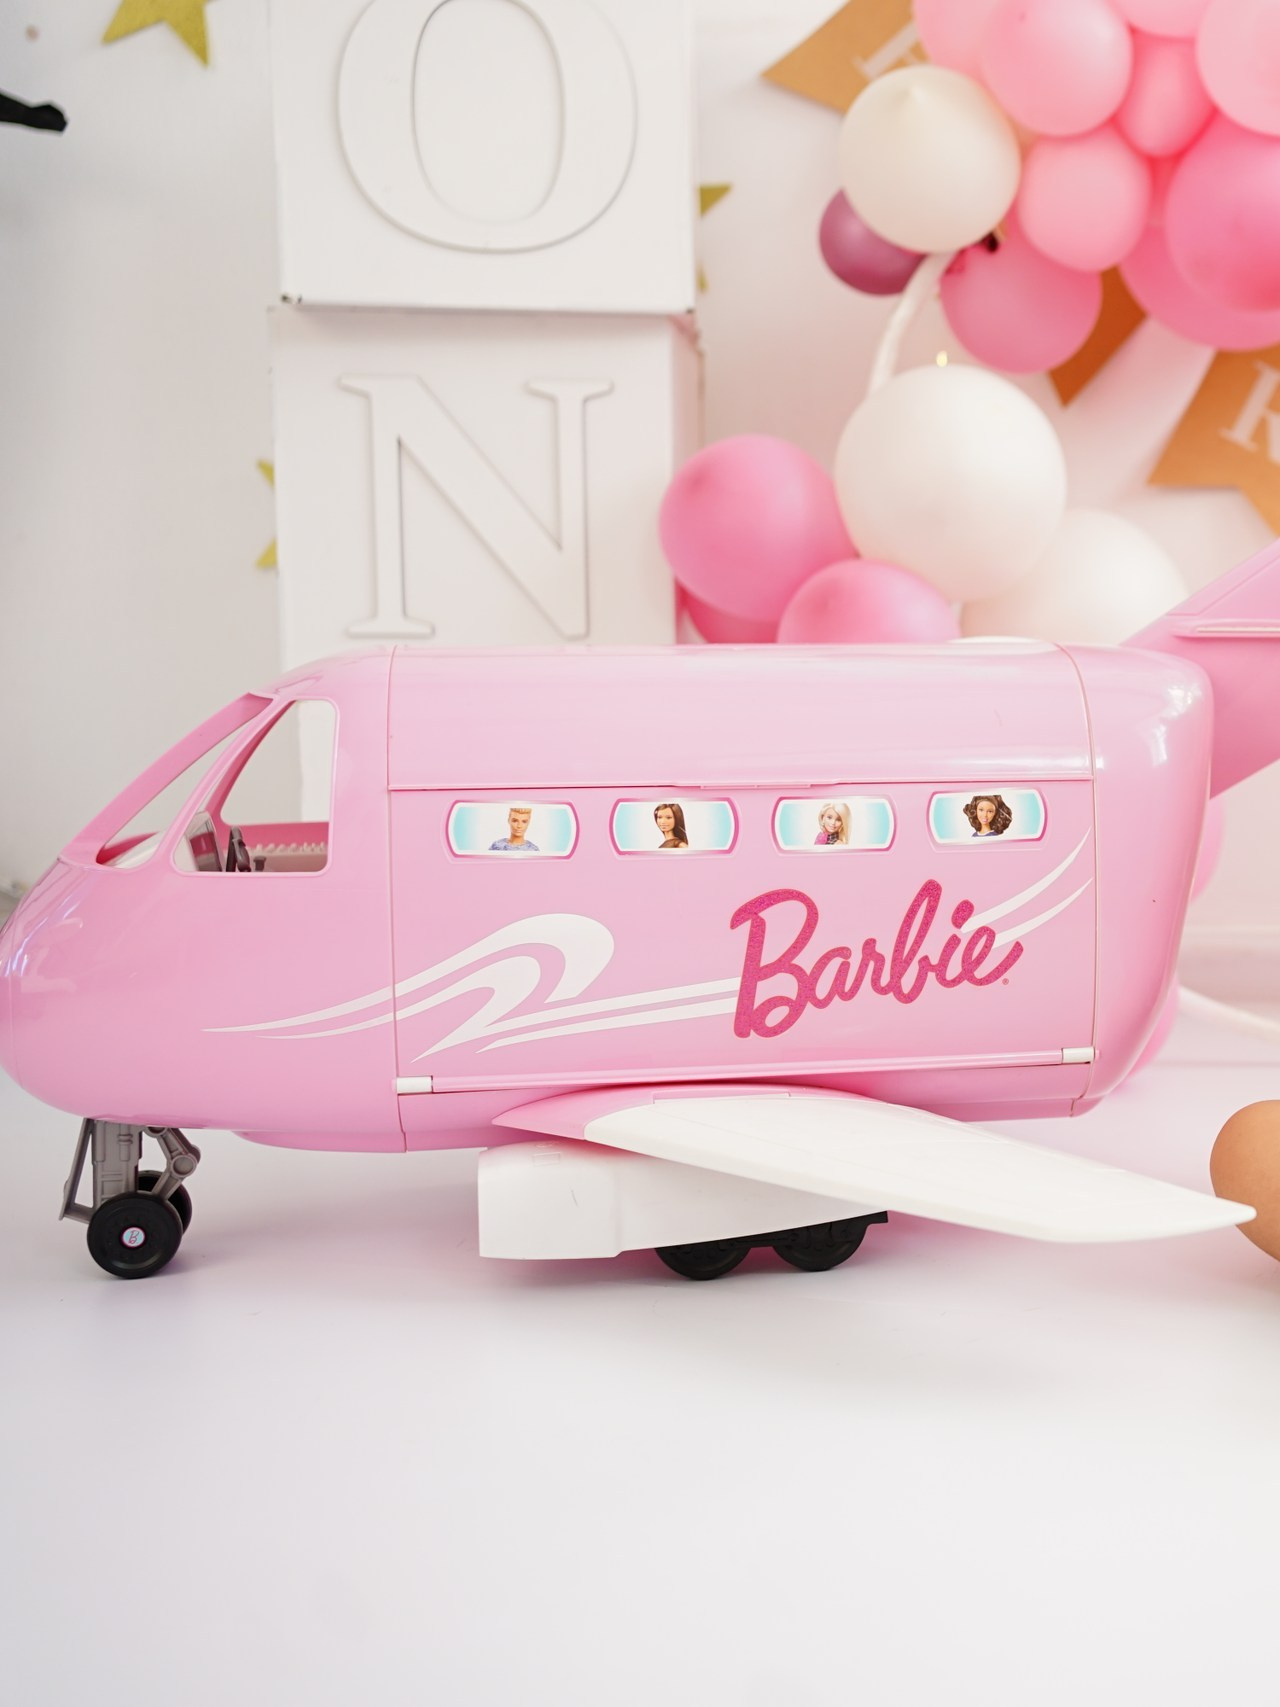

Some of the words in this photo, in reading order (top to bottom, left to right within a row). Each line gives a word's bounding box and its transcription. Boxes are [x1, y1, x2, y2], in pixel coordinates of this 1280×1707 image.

[335, 0, 638, 254] O
[337, 373, 614, 640] N
[730, 879, 1024, 1039] Barbie
